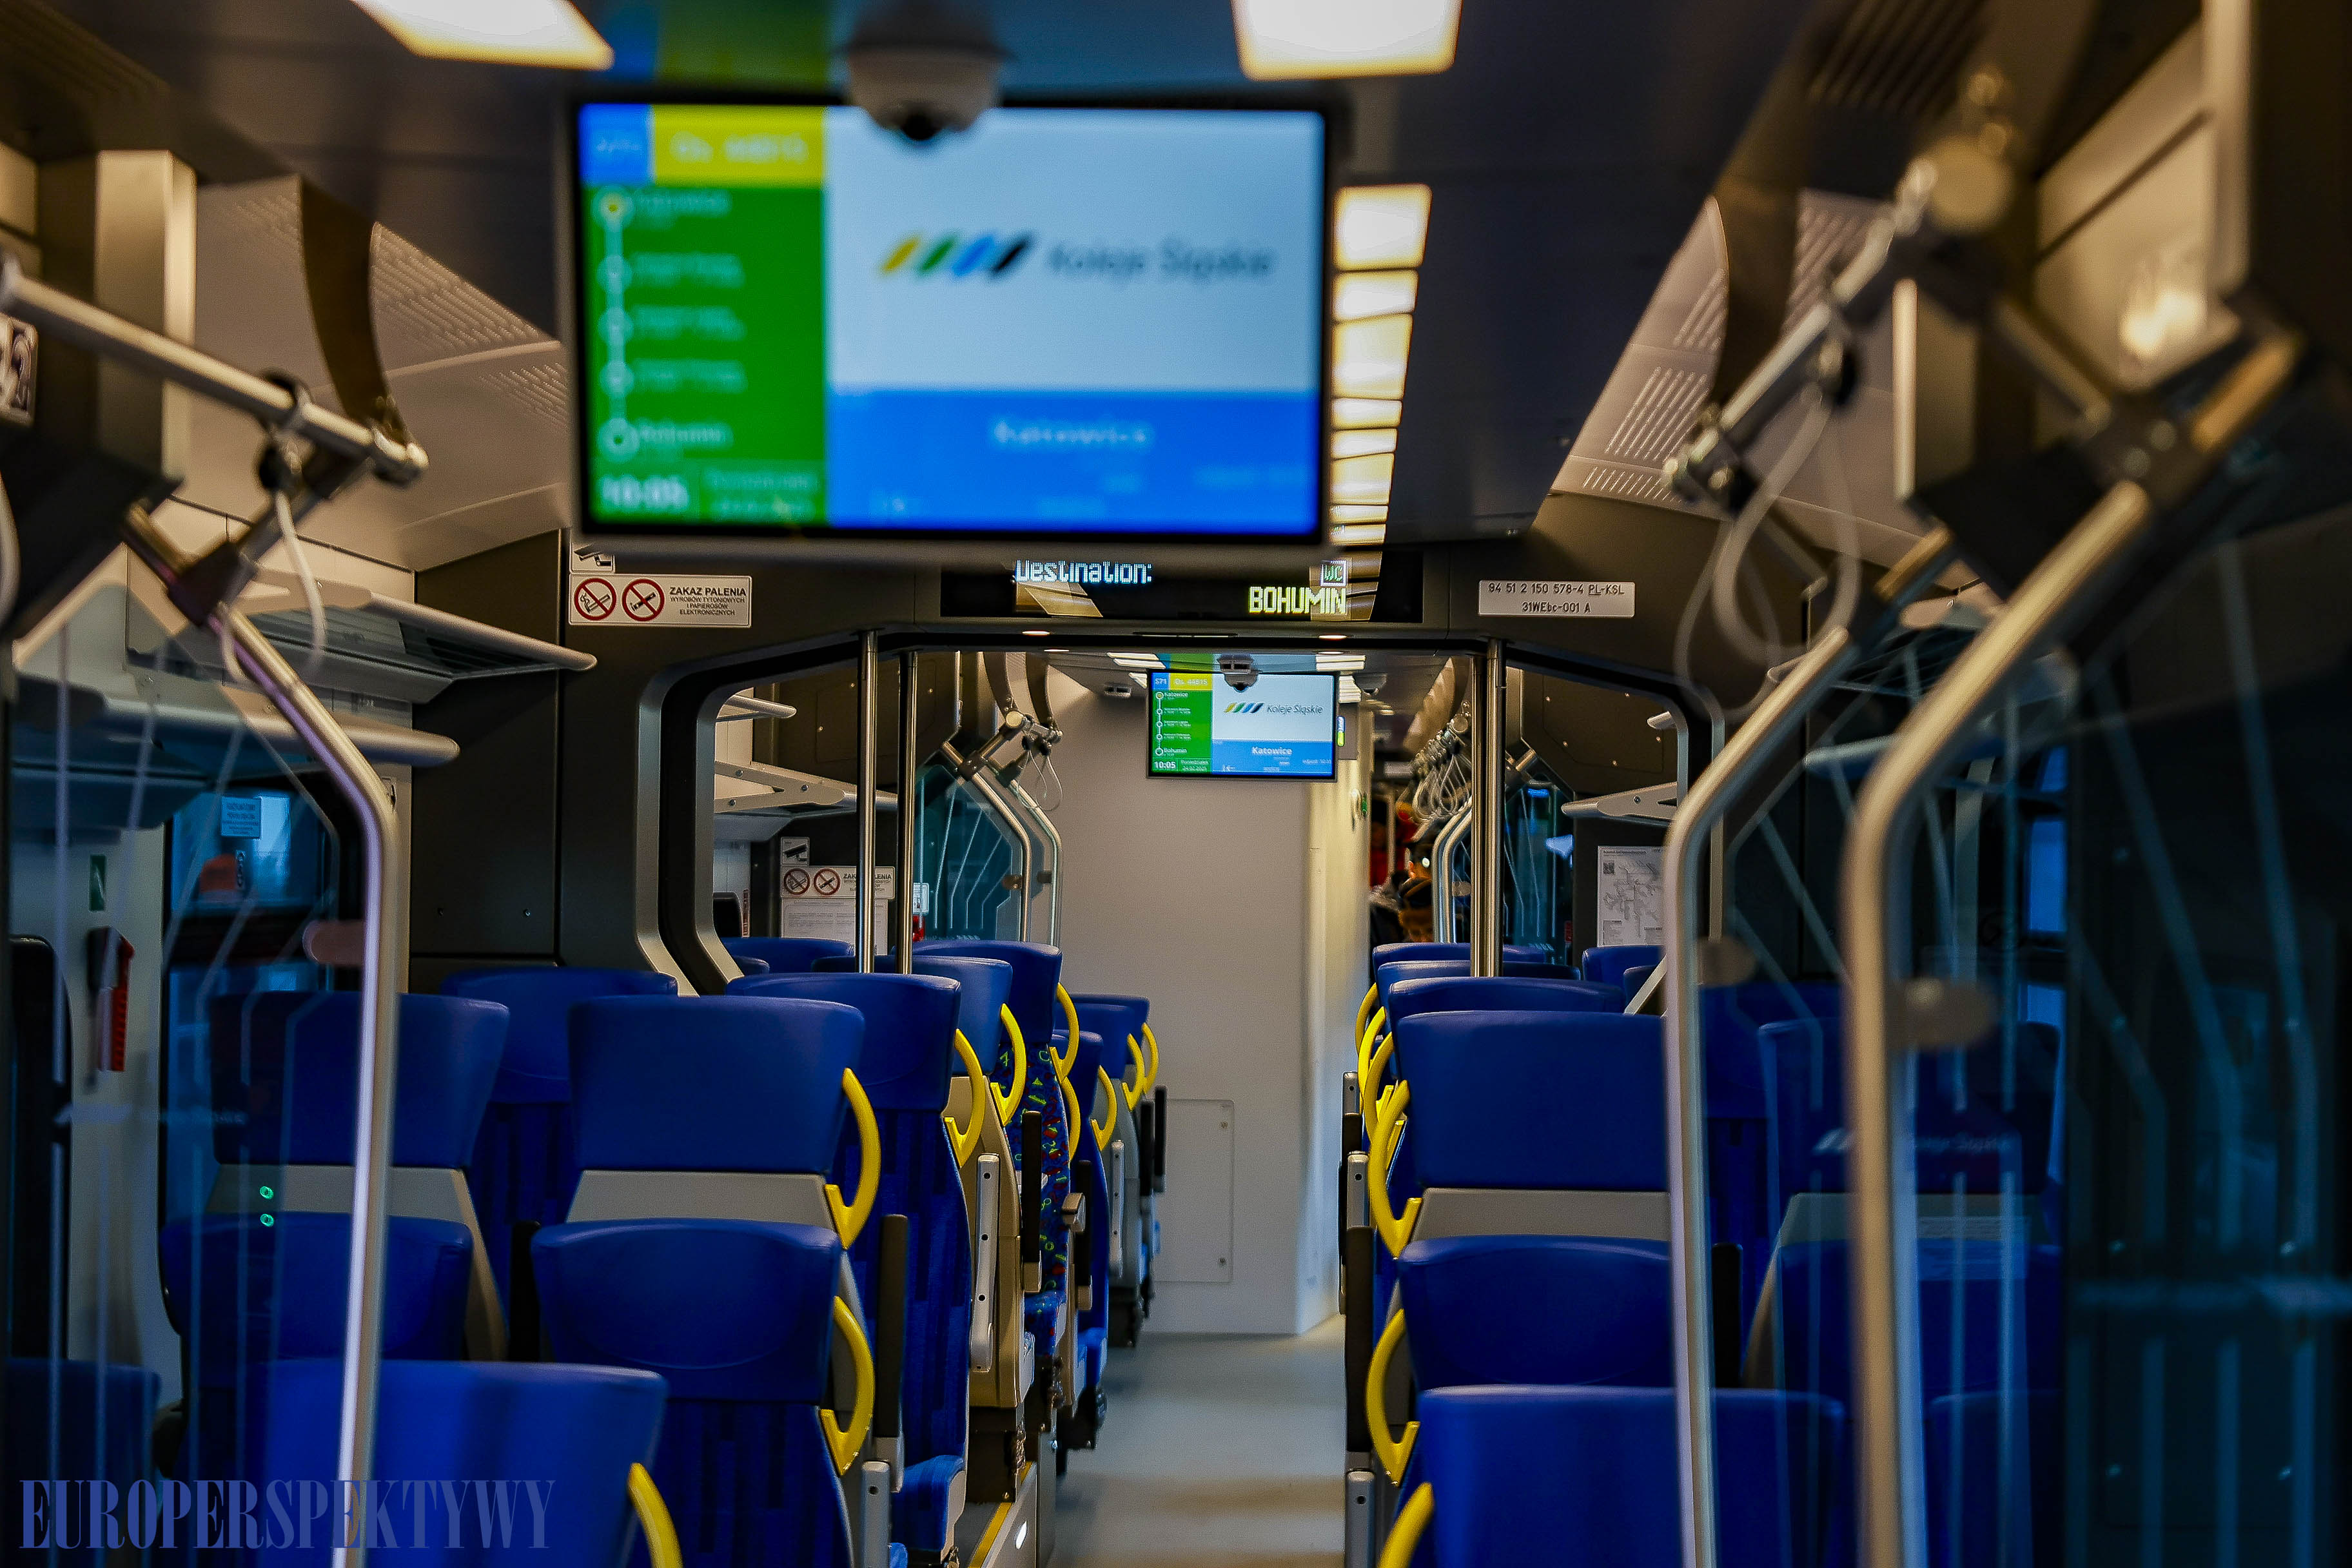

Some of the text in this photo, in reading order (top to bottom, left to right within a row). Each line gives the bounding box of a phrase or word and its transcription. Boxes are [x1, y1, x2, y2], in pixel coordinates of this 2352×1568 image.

[1016, 560, 1152, 583] Destination:
[1324, 565, 1343, 582] WC
[669, 587, 747, 596] ZAKAZ PALENIA
[1489, 582, 1625, 595] 94 51 2 150 578-4 PL-KSL
[1249, 586, 1346, 614] BOHUMIN
[1522, 602, 1591, 613] 31WEbc-001 A
[1268, 704, 1292, 714] Koleje
[1252, 747, 1292, 755] Katowice
